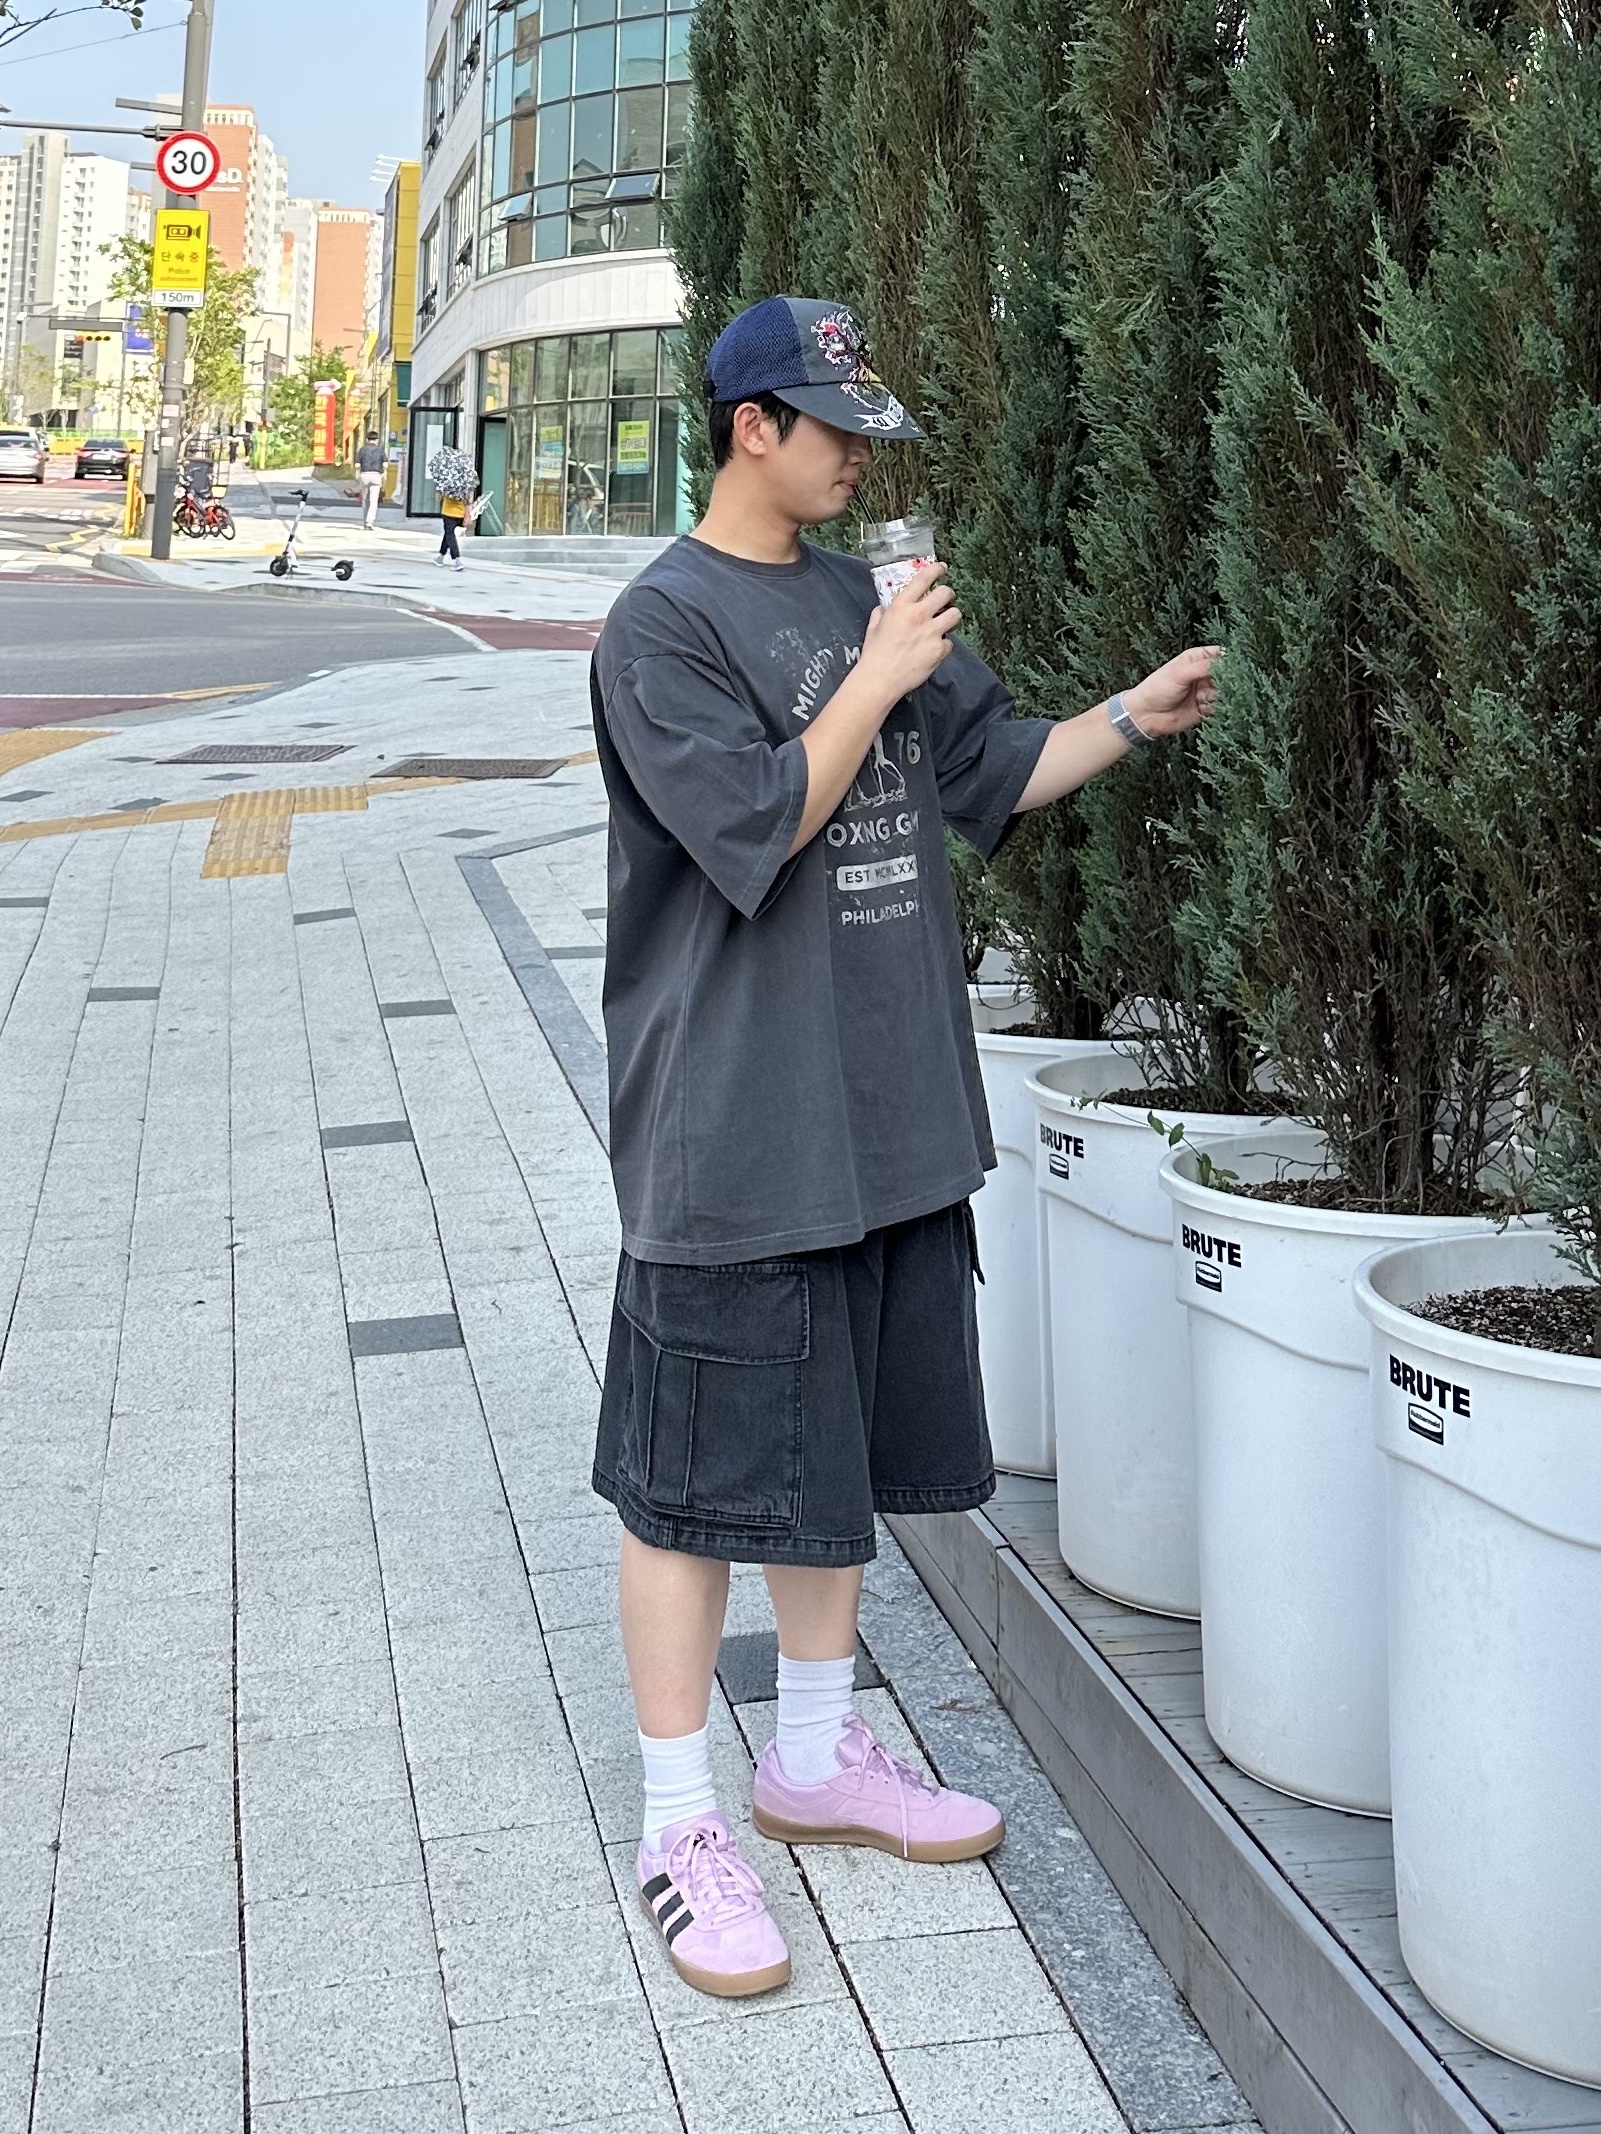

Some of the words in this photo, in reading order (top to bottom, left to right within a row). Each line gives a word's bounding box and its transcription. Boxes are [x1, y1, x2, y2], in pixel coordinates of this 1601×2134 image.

[171, 150, 207, 175] 30
[161, 292, 194, 303] 150m
[893, 730, 921, 765] 76
[845, 869, 870, 884] EST
[1040, 1122, 1084, 1159] BRUTE
[1182, 1223, 1242, 1268] BRUTE
[1389, 1353, 1471, 1418] BRUTE
